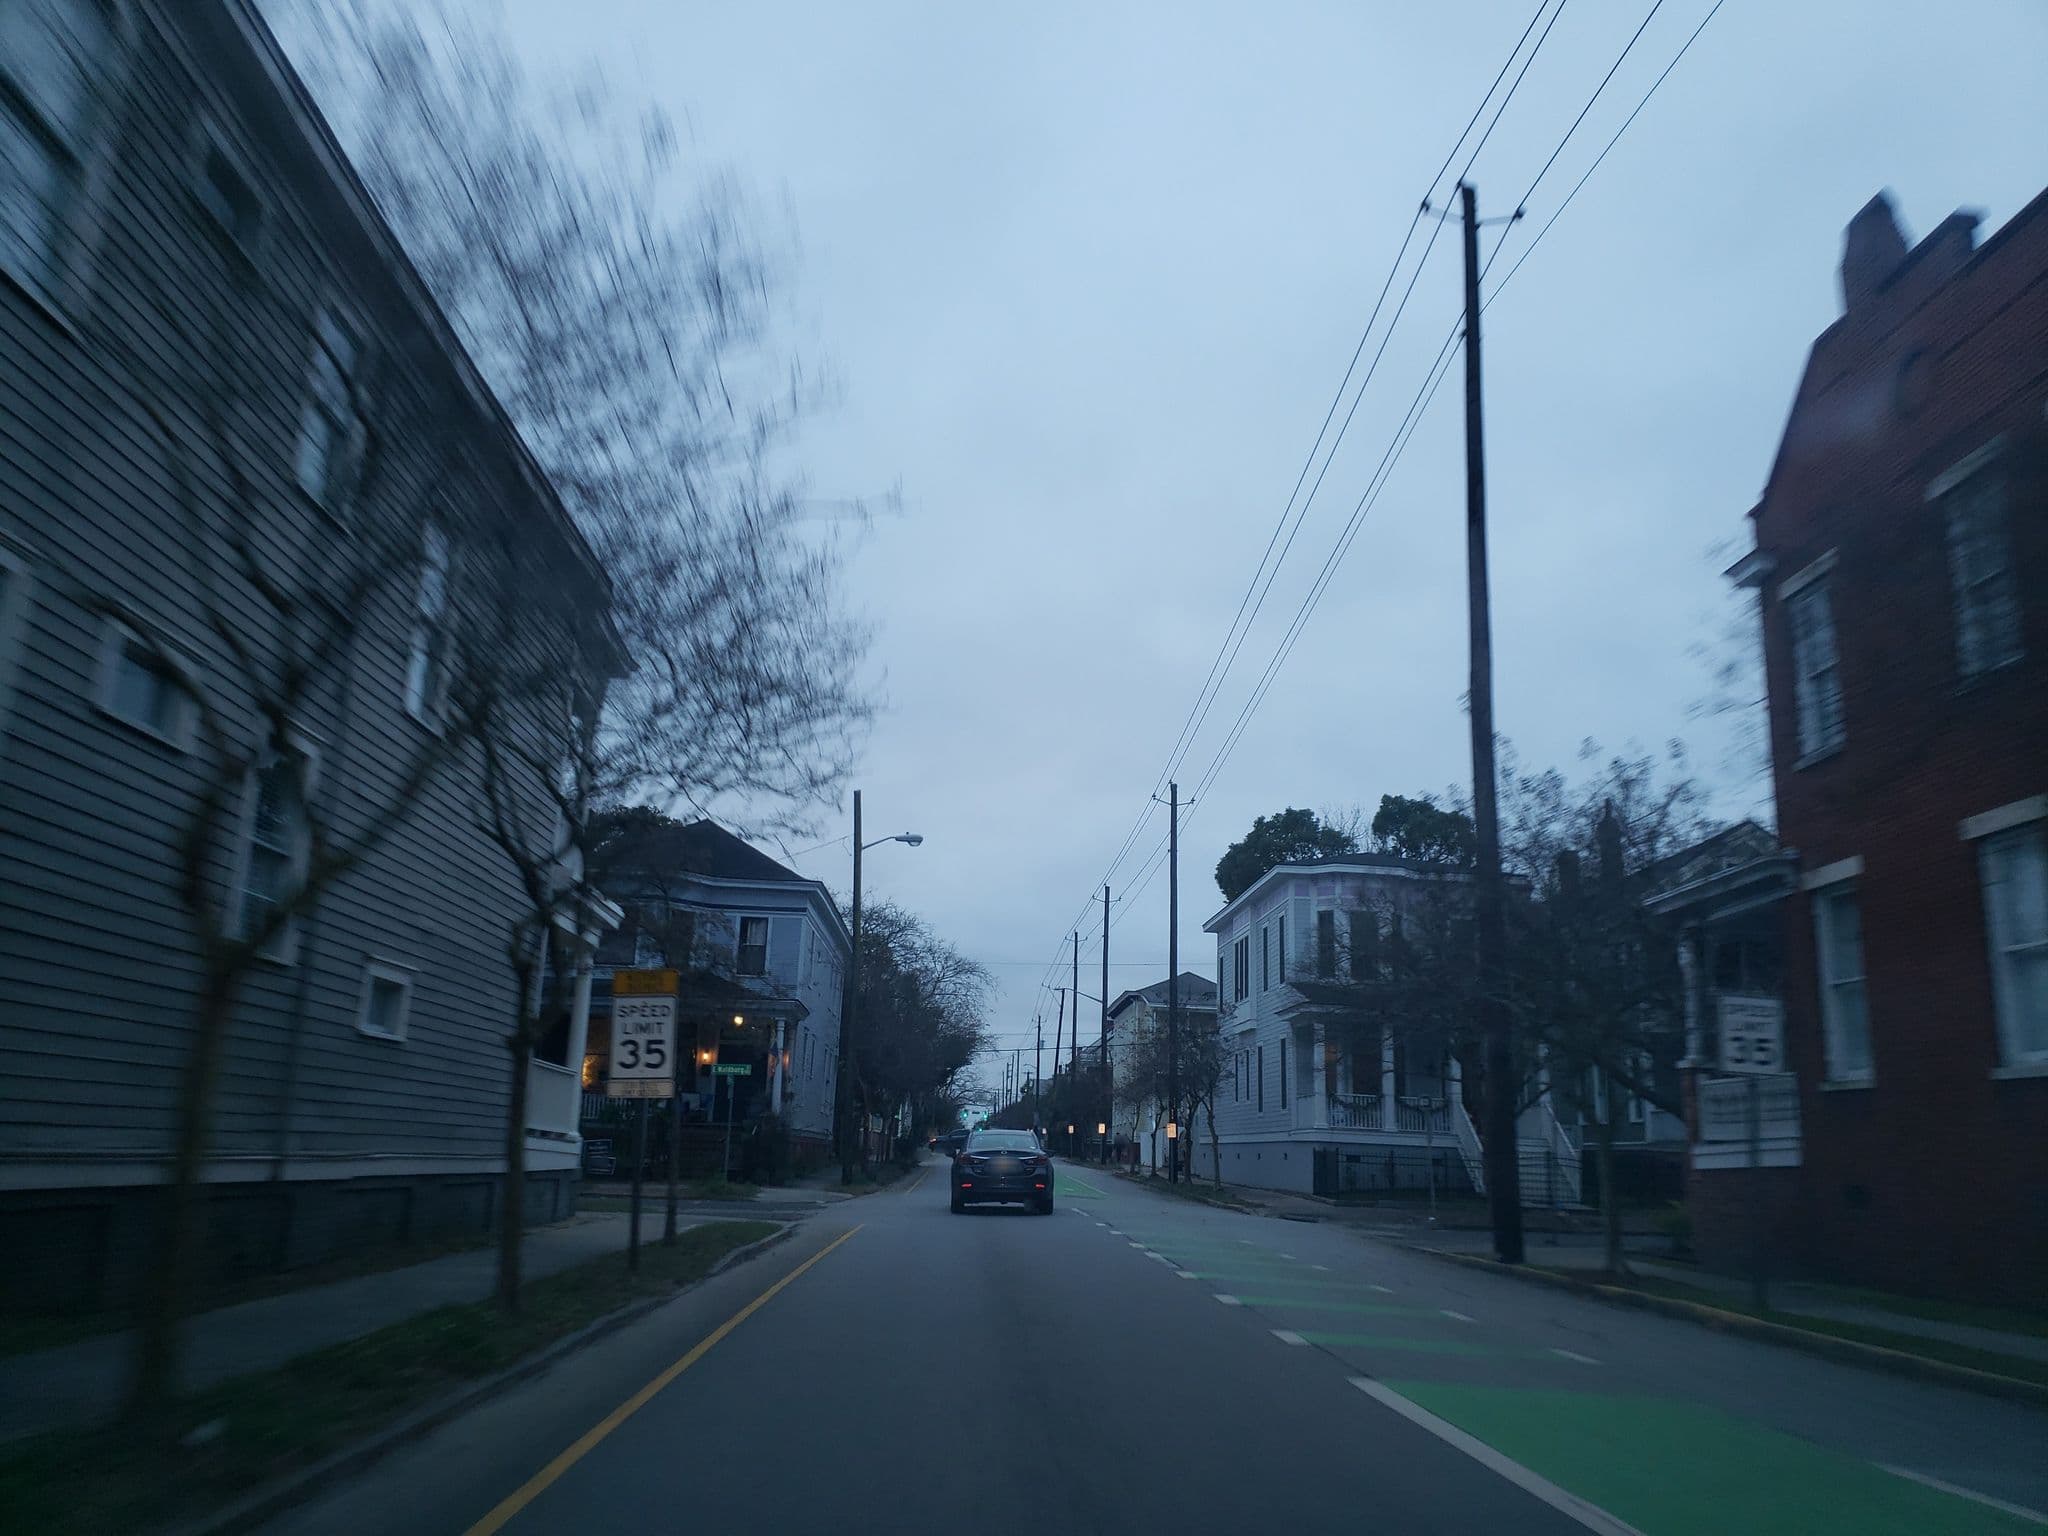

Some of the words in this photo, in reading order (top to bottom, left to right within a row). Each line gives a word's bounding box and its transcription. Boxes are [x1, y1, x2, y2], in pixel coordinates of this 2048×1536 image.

[617, 1005, 671, 1018] SPEED
[622, 1022, 665, 1035] LIMIT
[617, 1039, 667, 1070] 35
[1728, 1036, 1776, 1066] 35
